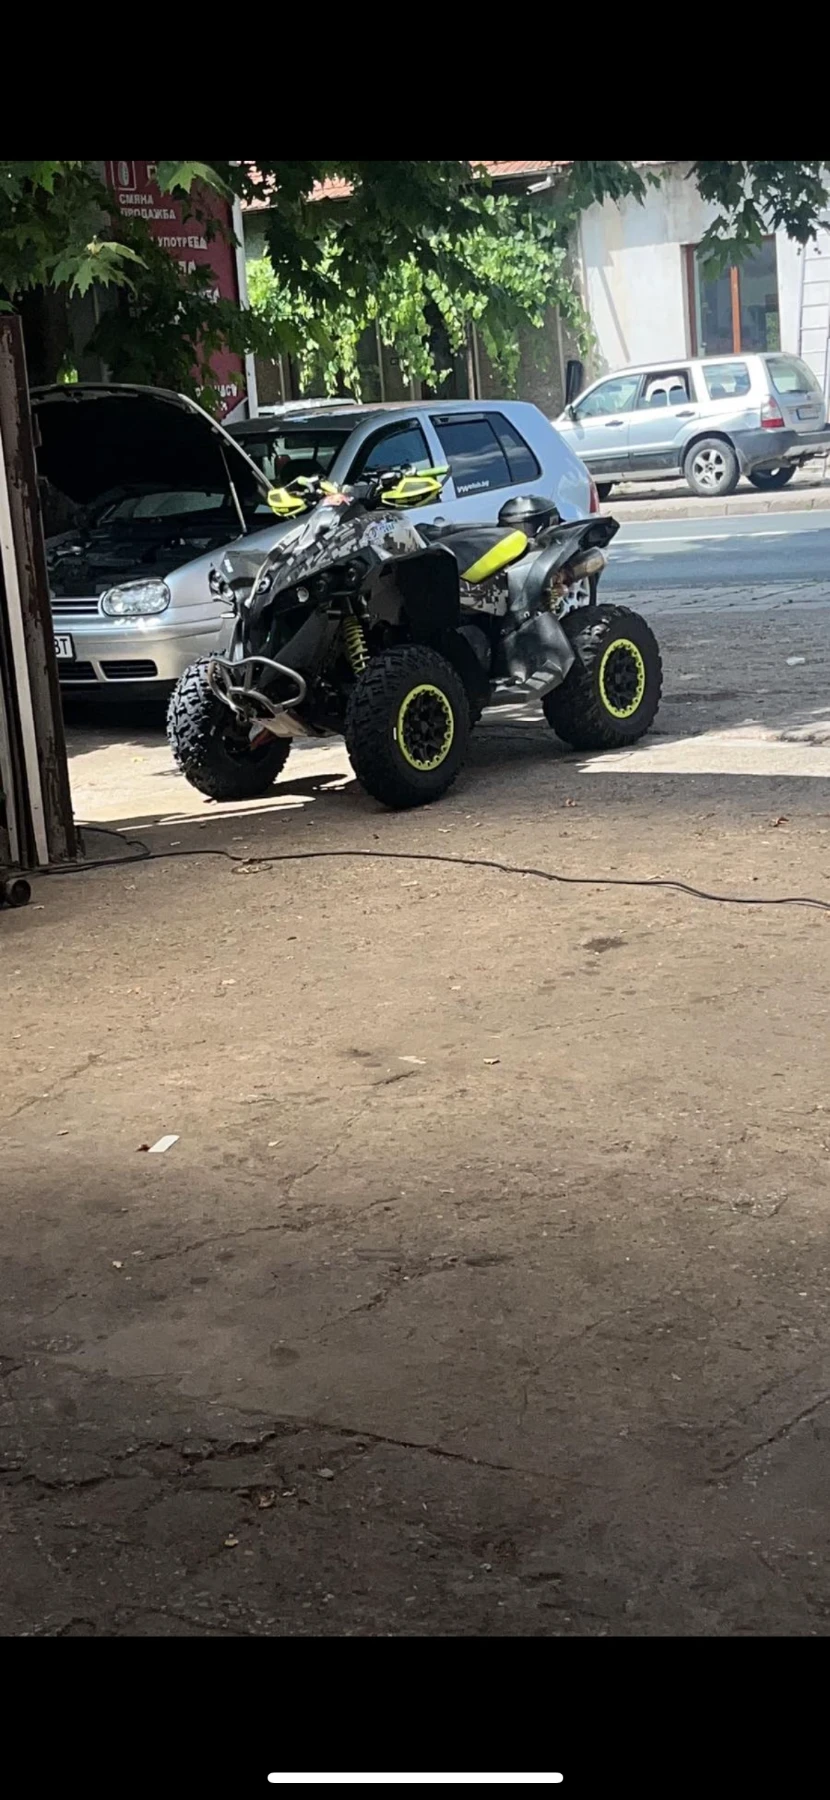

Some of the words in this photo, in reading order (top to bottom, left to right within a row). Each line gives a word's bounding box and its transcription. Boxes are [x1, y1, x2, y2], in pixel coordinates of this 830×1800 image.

[119, 194, 154, 205] СМЯНА
[120, 208, 176, 220] ПРОДАЖБА
[157, 235, 208, 250] УПОТРЕБА
